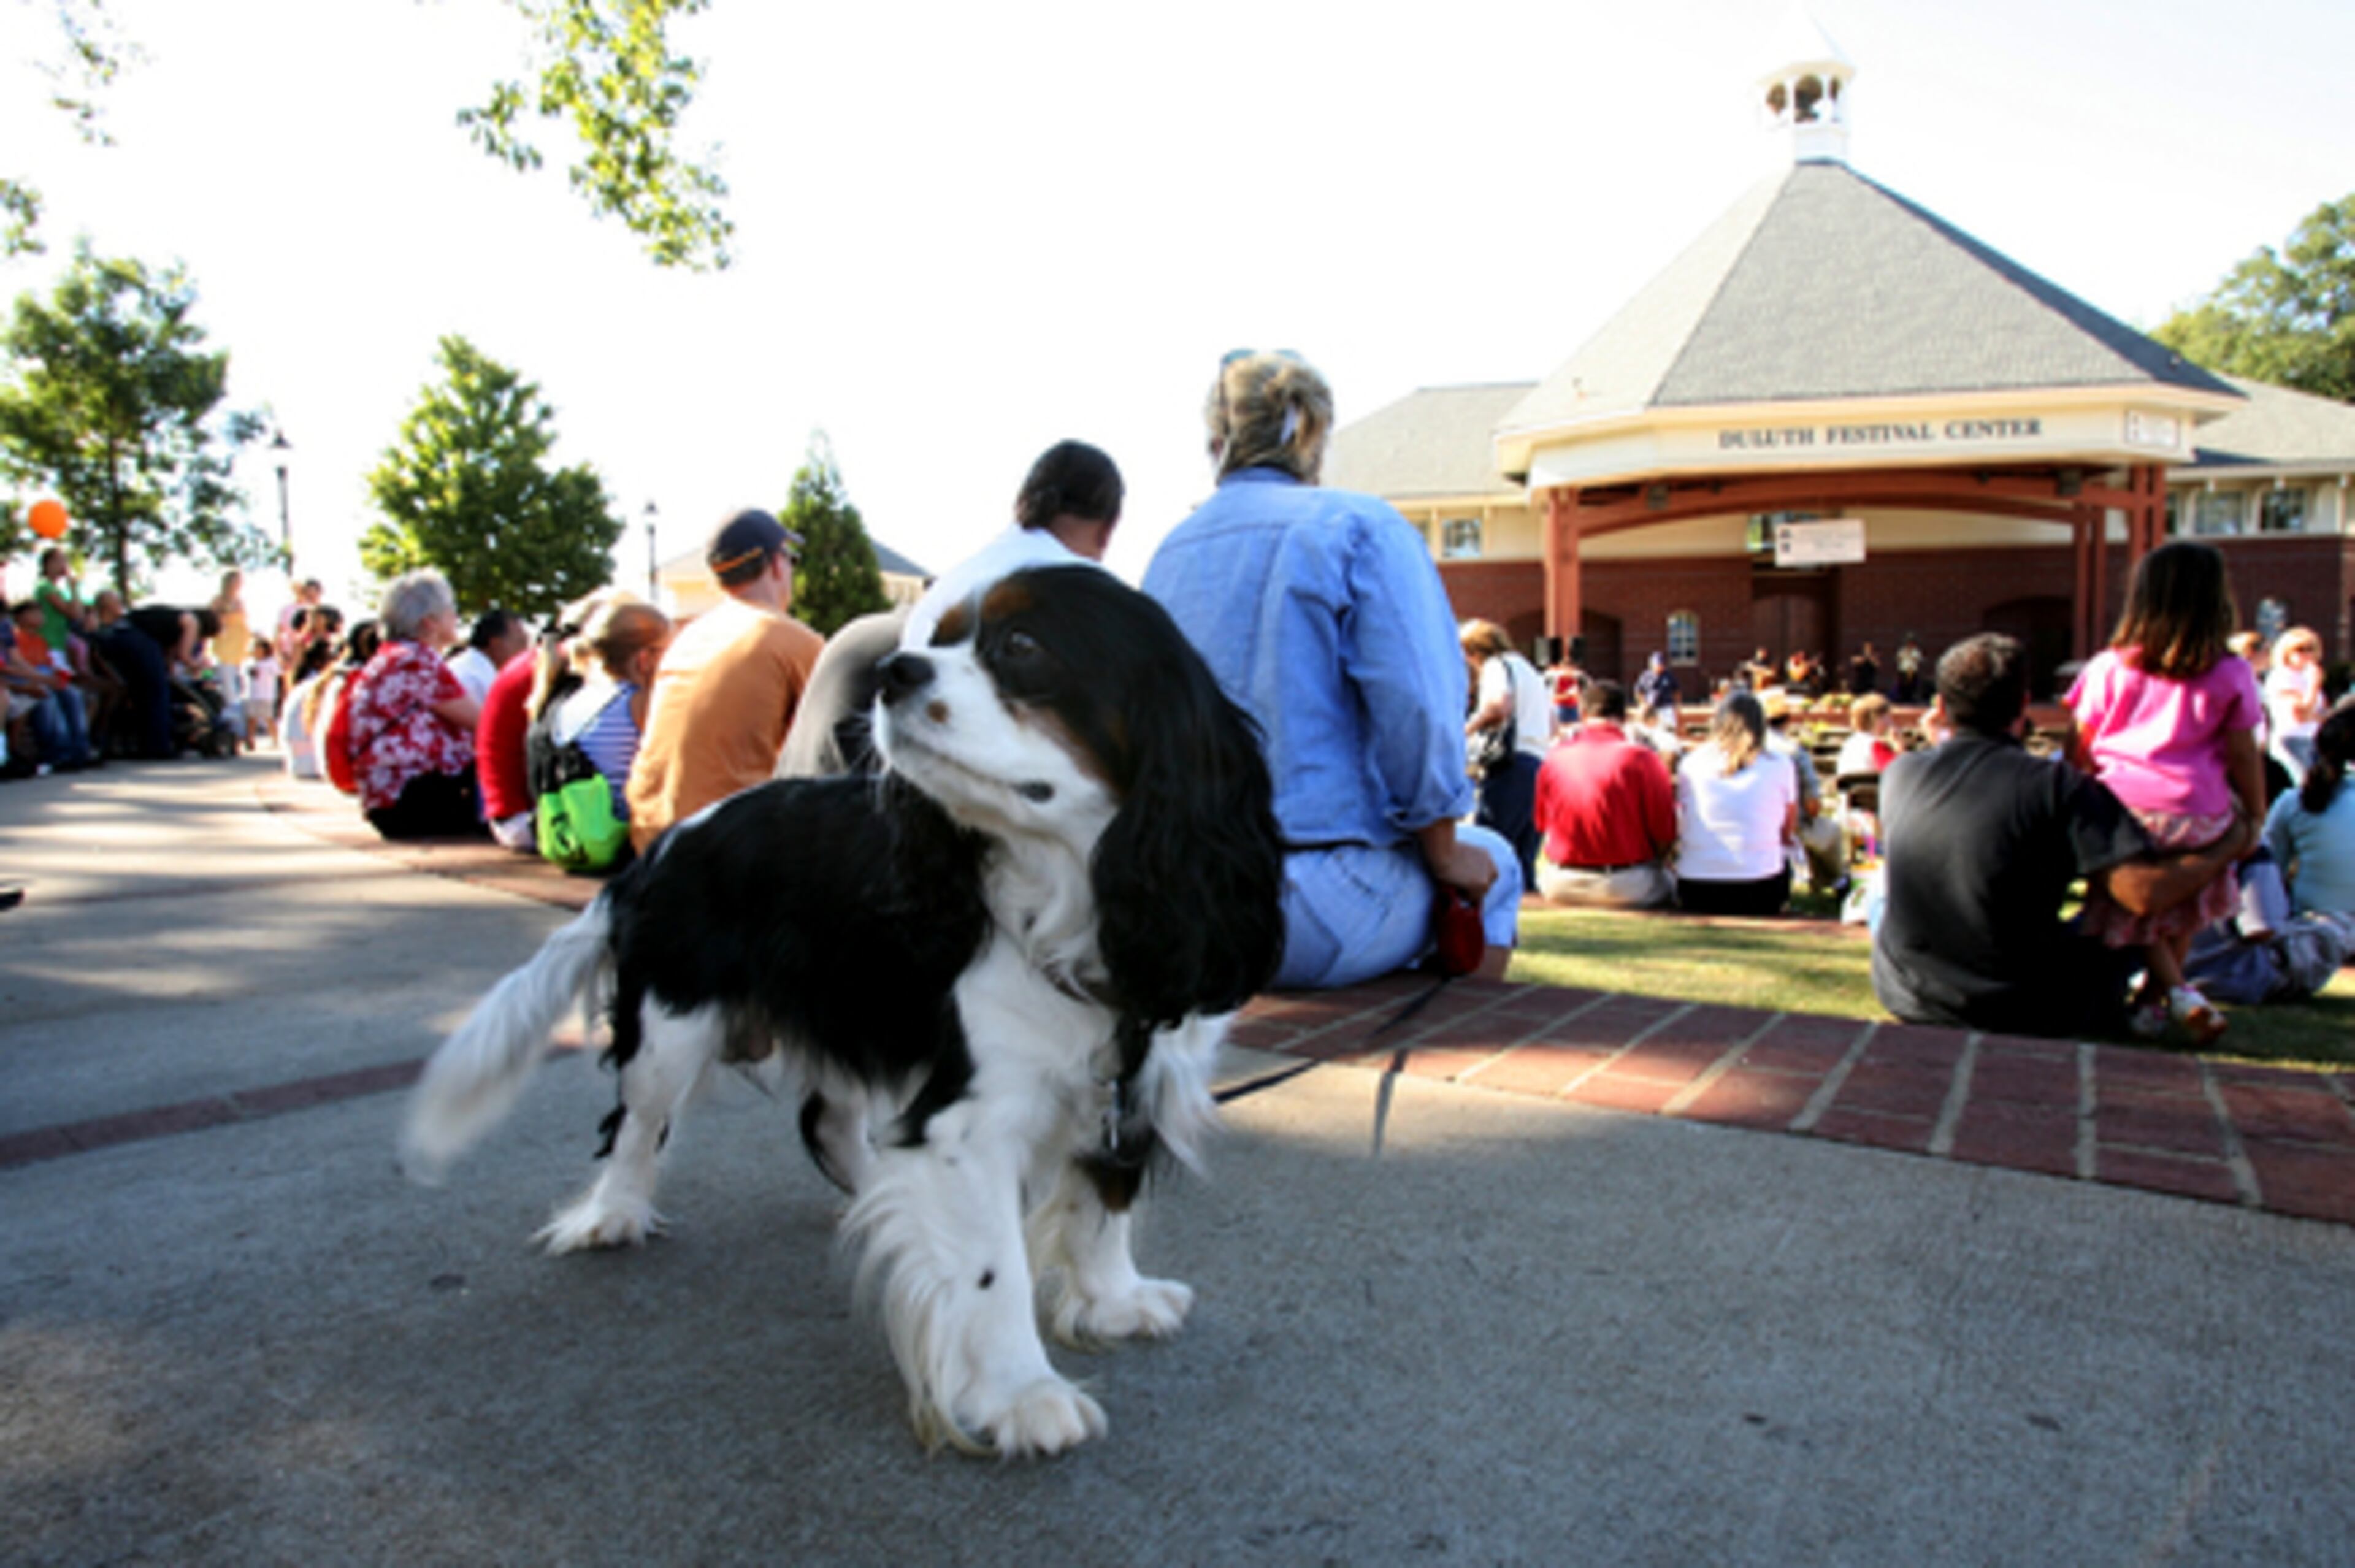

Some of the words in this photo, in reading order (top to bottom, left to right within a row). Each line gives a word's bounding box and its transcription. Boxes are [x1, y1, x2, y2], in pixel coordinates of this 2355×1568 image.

[1719, 426, 1814, 448] DULUTH
[1826, 423, 1935, 445] FESTIVAL
[1945, 418, 2042, 439] CENTER
